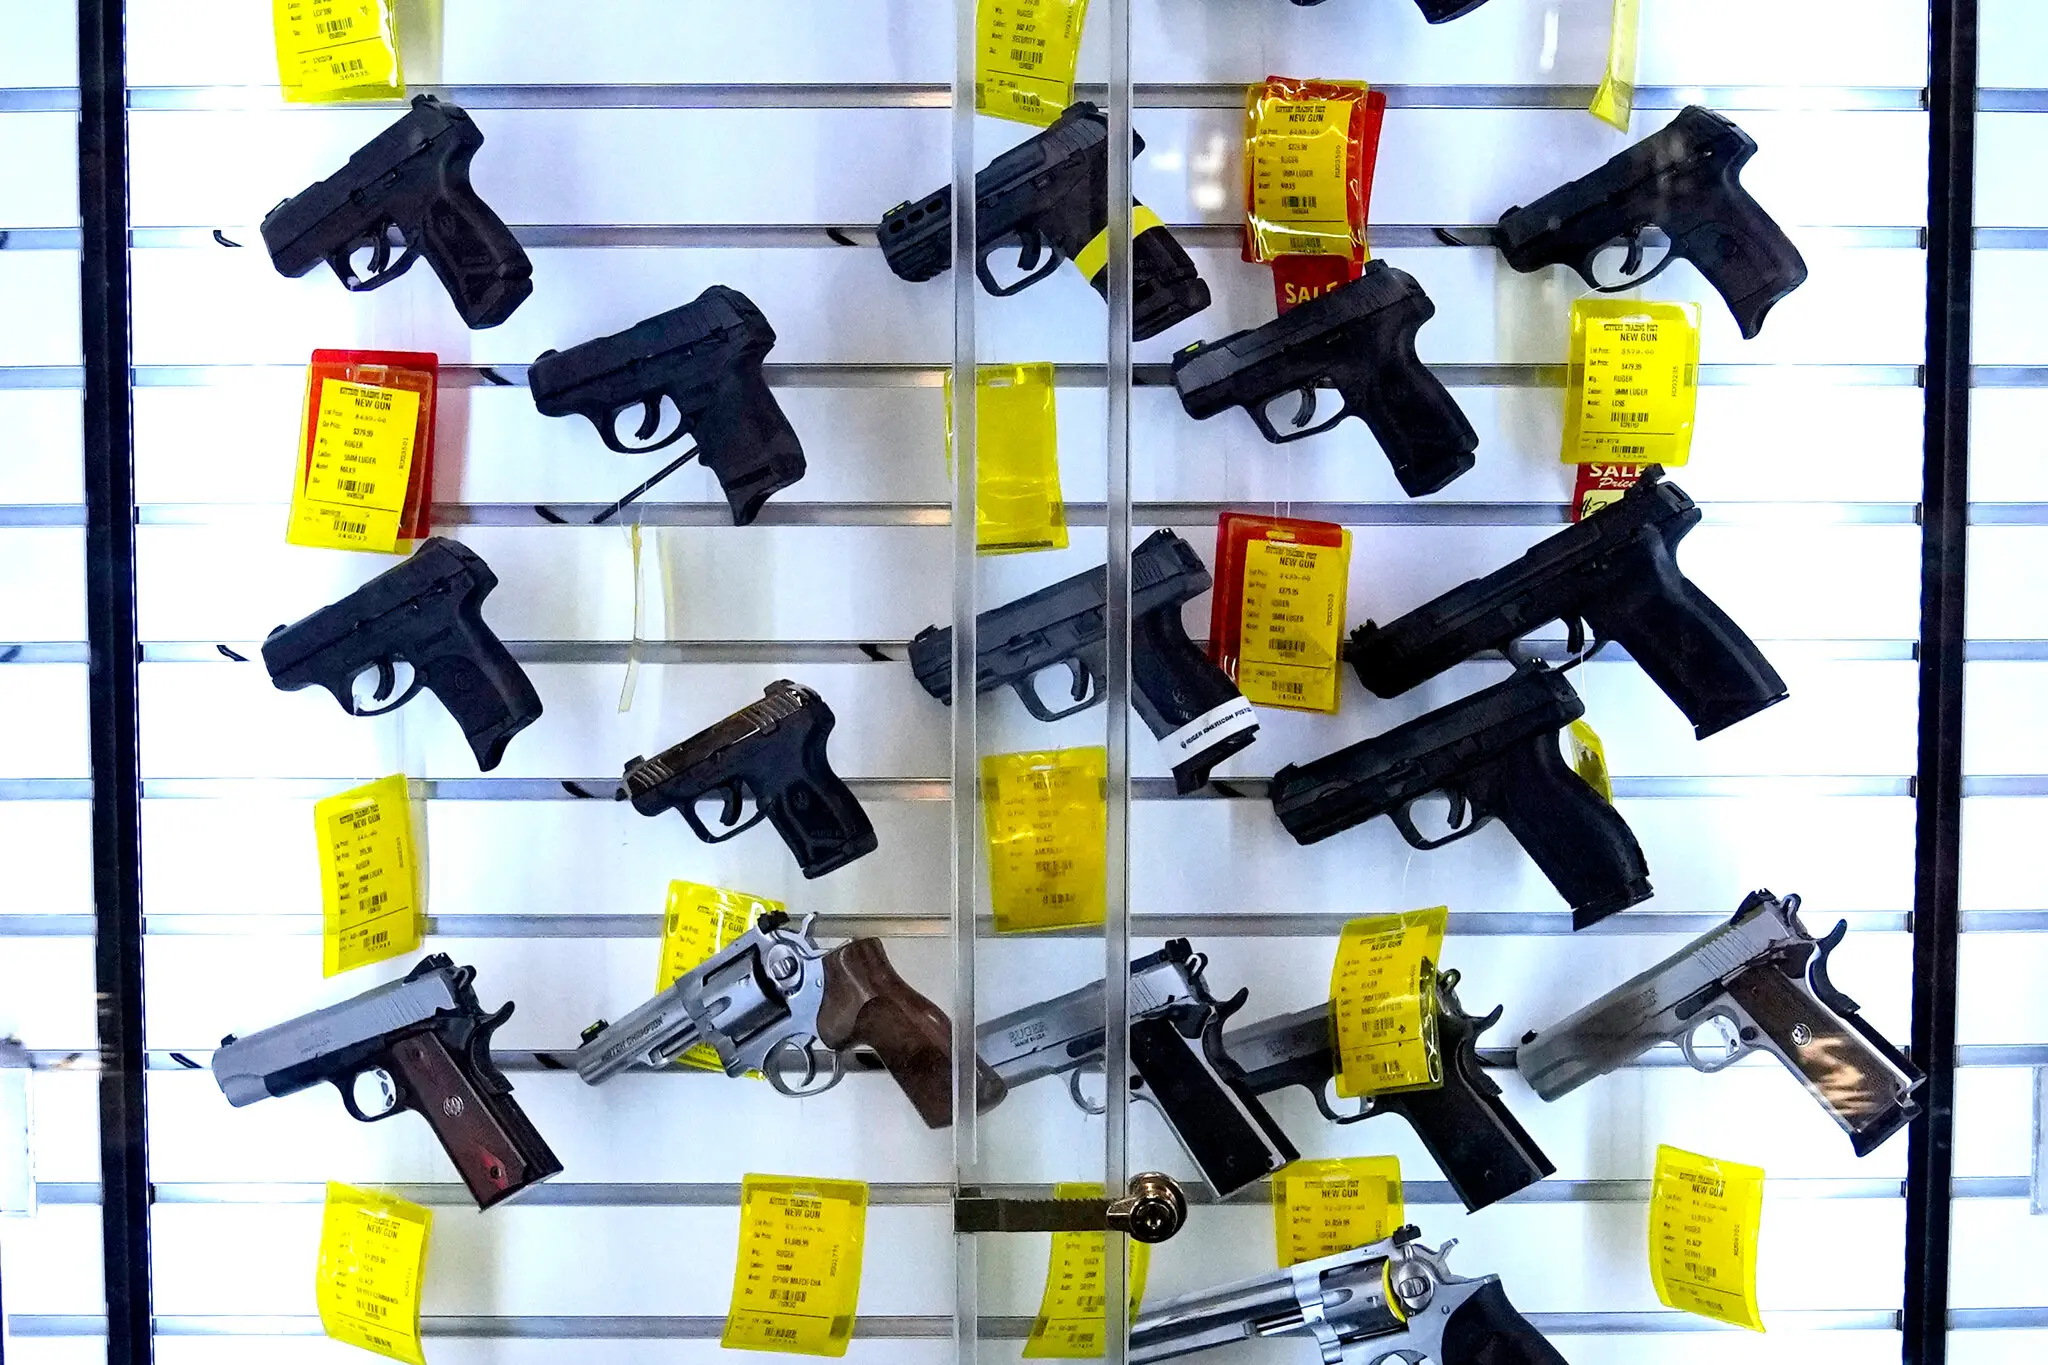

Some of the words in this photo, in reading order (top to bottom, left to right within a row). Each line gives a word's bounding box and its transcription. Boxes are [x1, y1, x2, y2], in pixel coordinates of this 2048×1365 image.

[1289, 114, 1305, 122] NEW
[1307, 114, 1324, 122] GUN
[1620, 333, 1638, 341] NEW
[1640, 333, 1657, 341] GUN
[354, 398, 372, 408] NEW
[374, 401, 391, 411] GUN
[1279, 557, 1296, 567] NEW
[1298, 559, 1315, 568] GUN
[1203, 714, 1234, 733] AMERICAN
[353, 816, 367, 829] NEW
[367, 813, 381, 824] GUN
[728, 921, 744, 933] GUN
[1321, 1189, 1339, 1198] NEW
[1341, 1189, 1358, 1197] GUN
[1692, 1183, 1707, 1194] NEW
[1709, 1187, 1724, 1198] GUN
[784, 1207, 802, 1217] NEW
[804, 1209, 820, 1219] GUN
[367, 1223, 381, 1235] NEW
[383, 1228, 397, 1239] GUN
